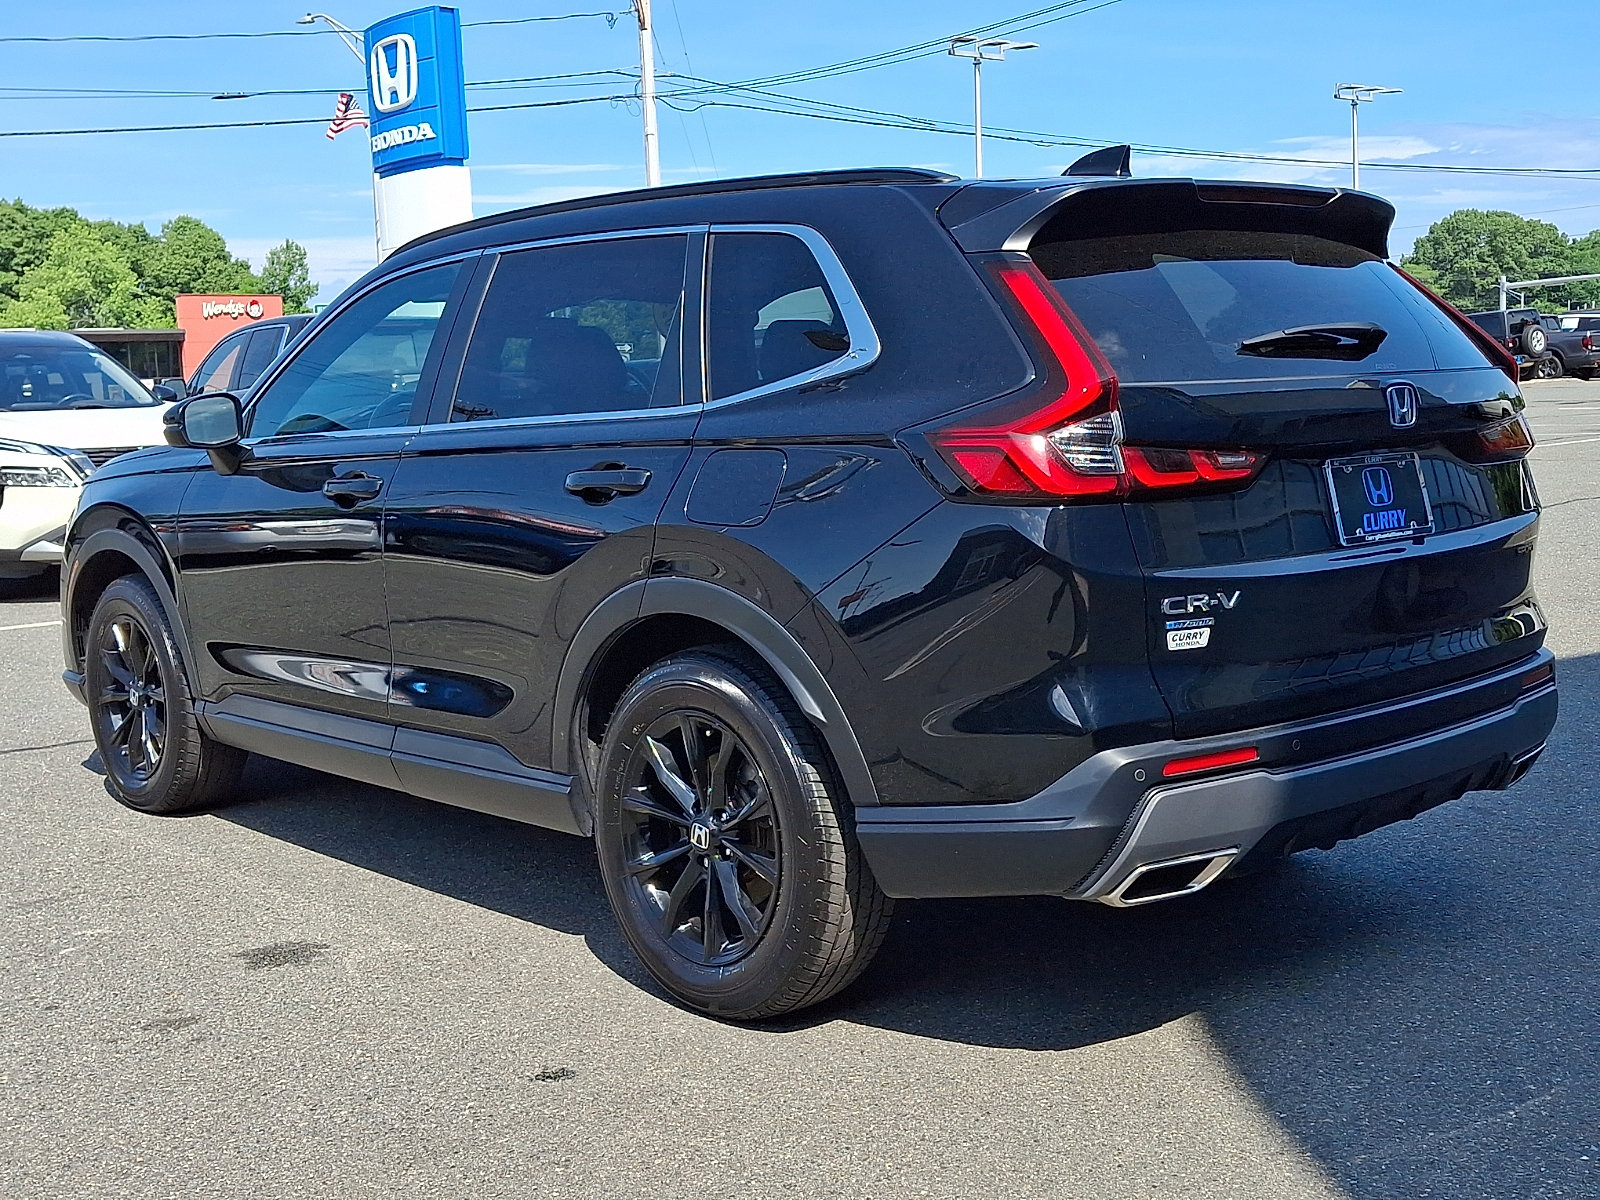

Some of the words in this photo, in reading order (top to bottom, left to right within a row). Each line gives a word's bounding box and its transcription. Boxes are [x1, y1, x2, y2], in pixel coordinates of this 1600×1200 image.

[371, 122, 437, 152] HONDA
[1363, 509, 1406, 532] CURRY
[1161, 590, 1241, 614] CR-V
[1171, 631, 1205, 642] CURRY
